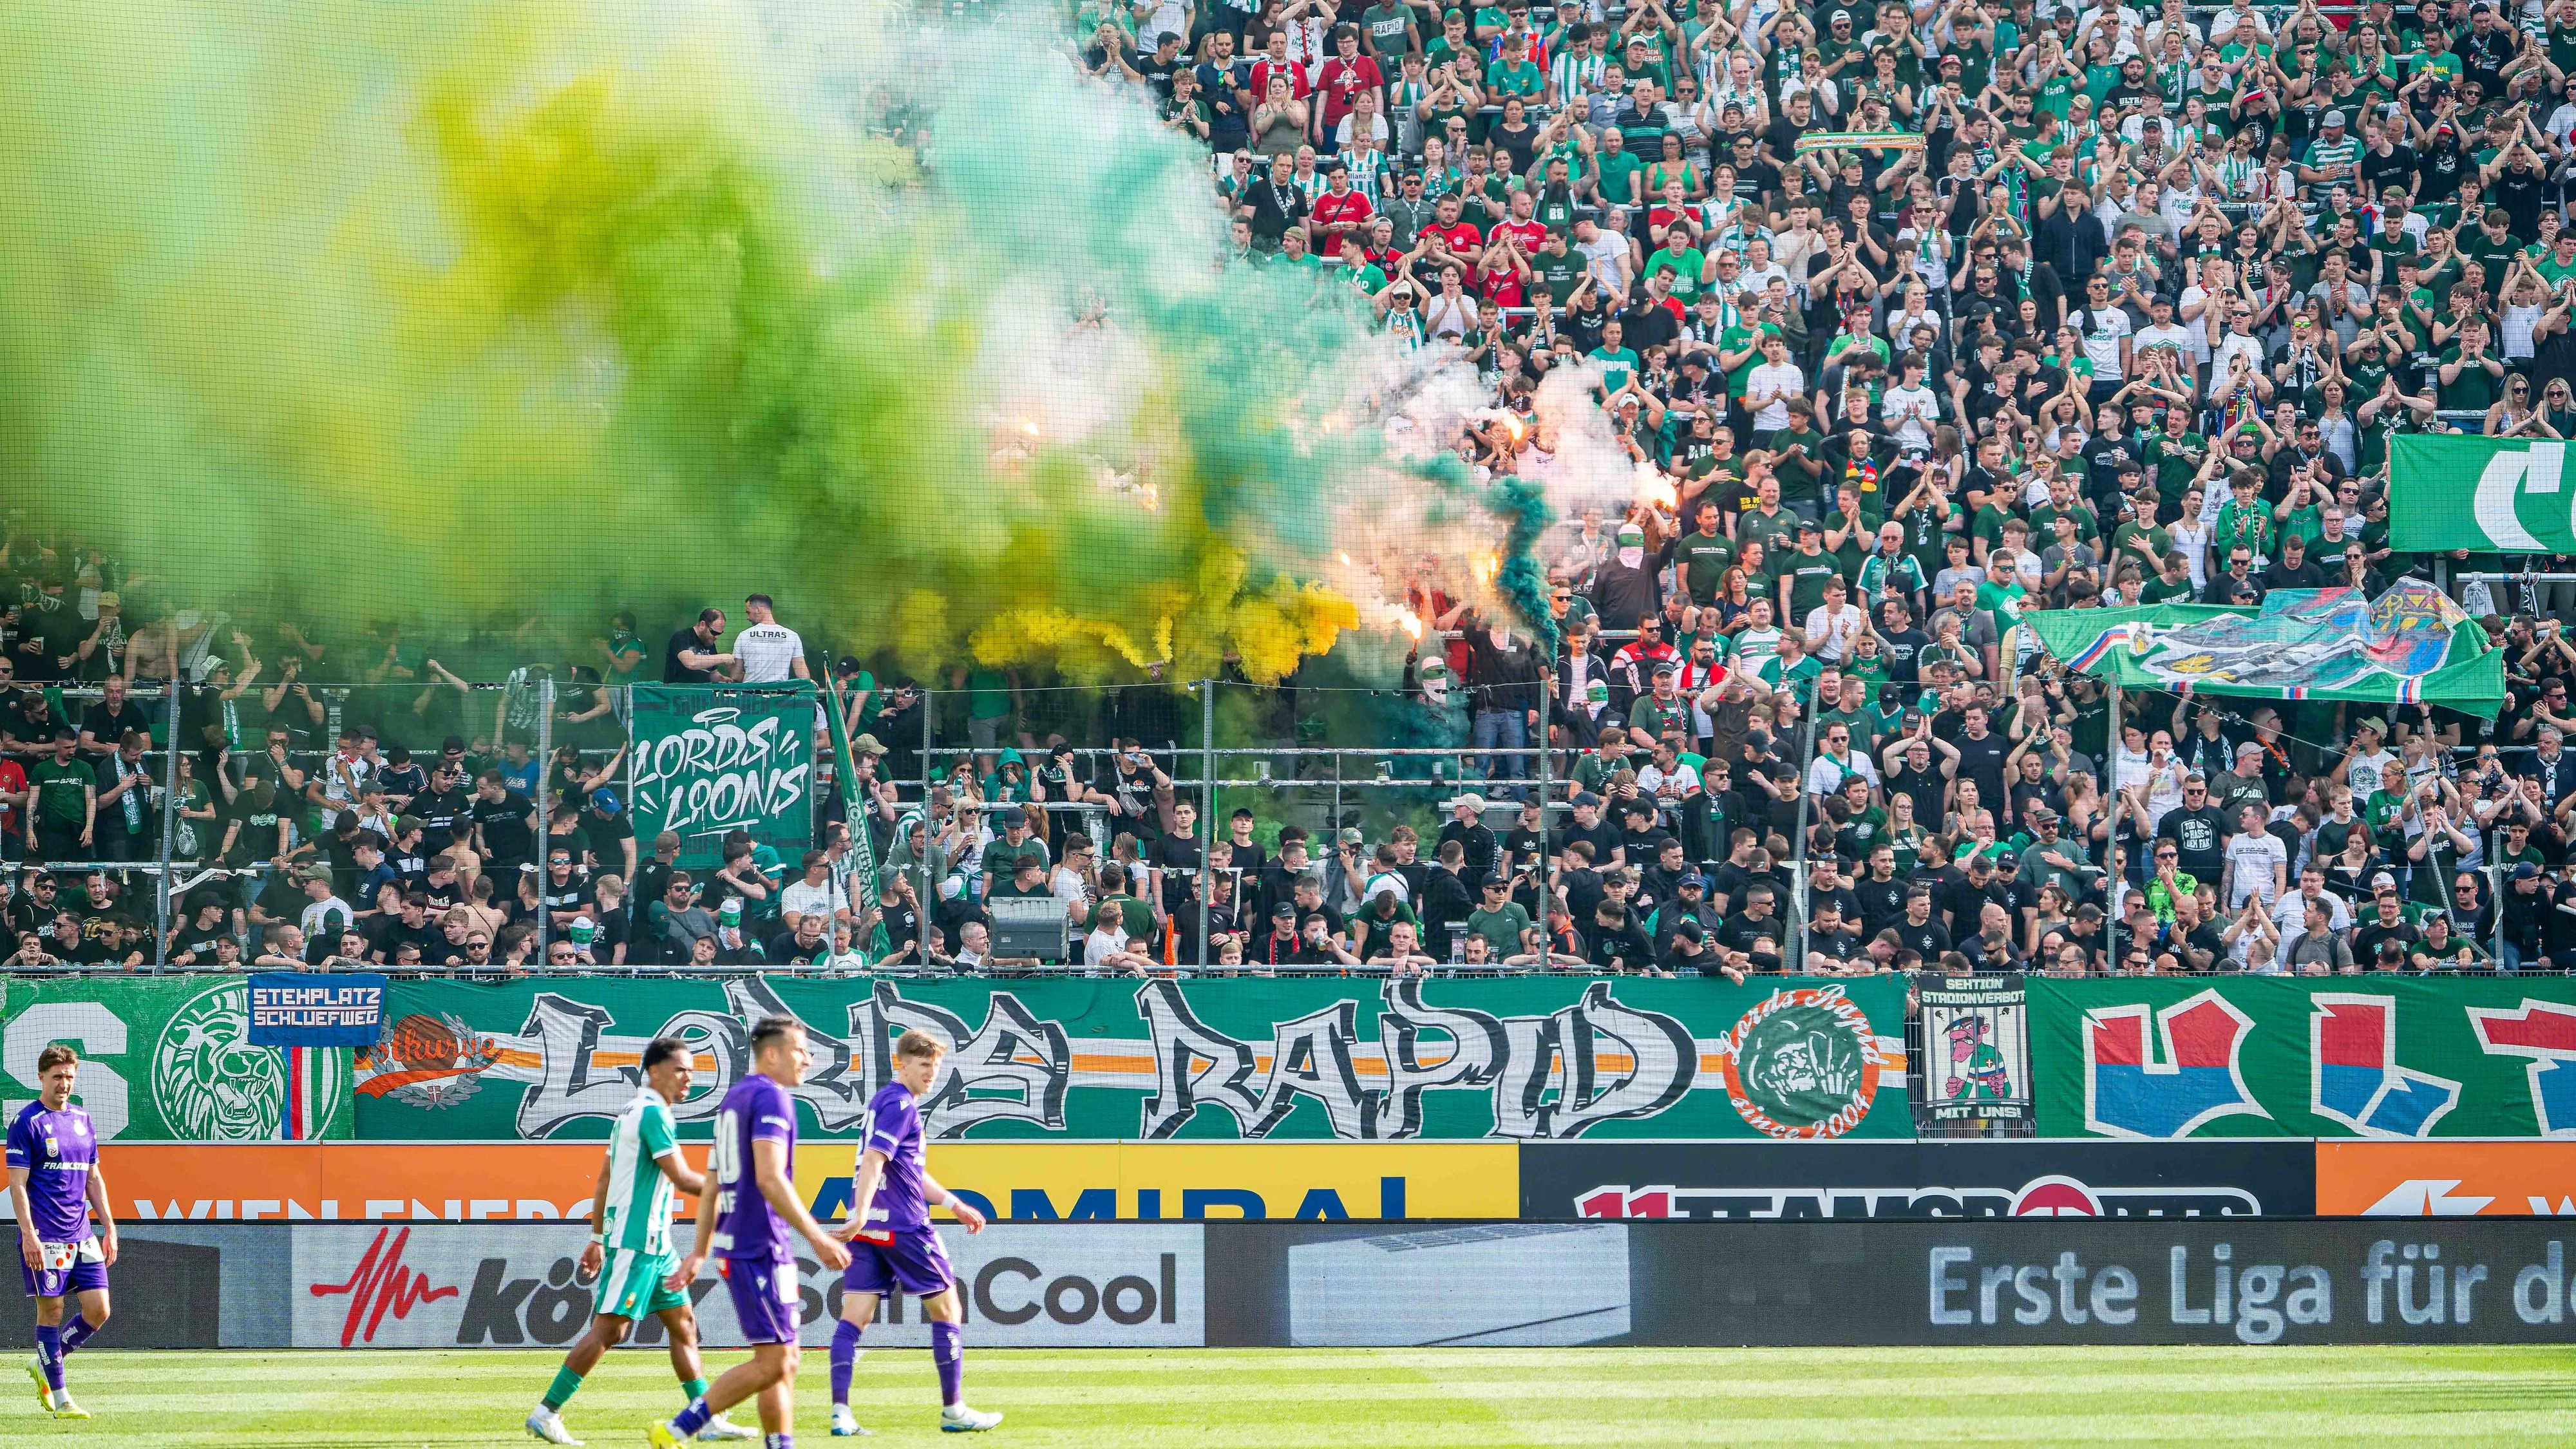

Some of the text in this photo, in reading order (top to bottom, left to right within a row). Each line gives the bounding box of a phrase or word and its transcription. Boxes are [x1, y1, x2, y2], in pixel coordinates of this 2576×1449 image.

[1375, 21, 1400, 35] RAPID
[749, 630, 787, 639] ULTRAS
[634, 716, 779, 787] LORDS
[1116, 784, 1151, 792] eesse
[2232, 786, 2263, 799] ulras
[663, 762, 810, 832] LOONS
[2184, 820, 2195, 830] TOD
[2190, 829, 2205, 839] HASS
[2197, 838, 2210, 848] FAK
[253, 987, 381, 1005] STEHPLATZ
[1922, 990, 2026, 1004] STADIONVERBOT
[254, 1010, 379, 1026] SCHLUEFWEG
[1714, 983, 1891, 1066] Lords Rapid
[1133, 977, 1698, 1139] RAPID
[1731, 1088, 1871, 1139] since 2004
[1935, 1106, 2022, 1119] MIT UNS!
[1929, 1239, 2576, 1345] Erste Liga für d
